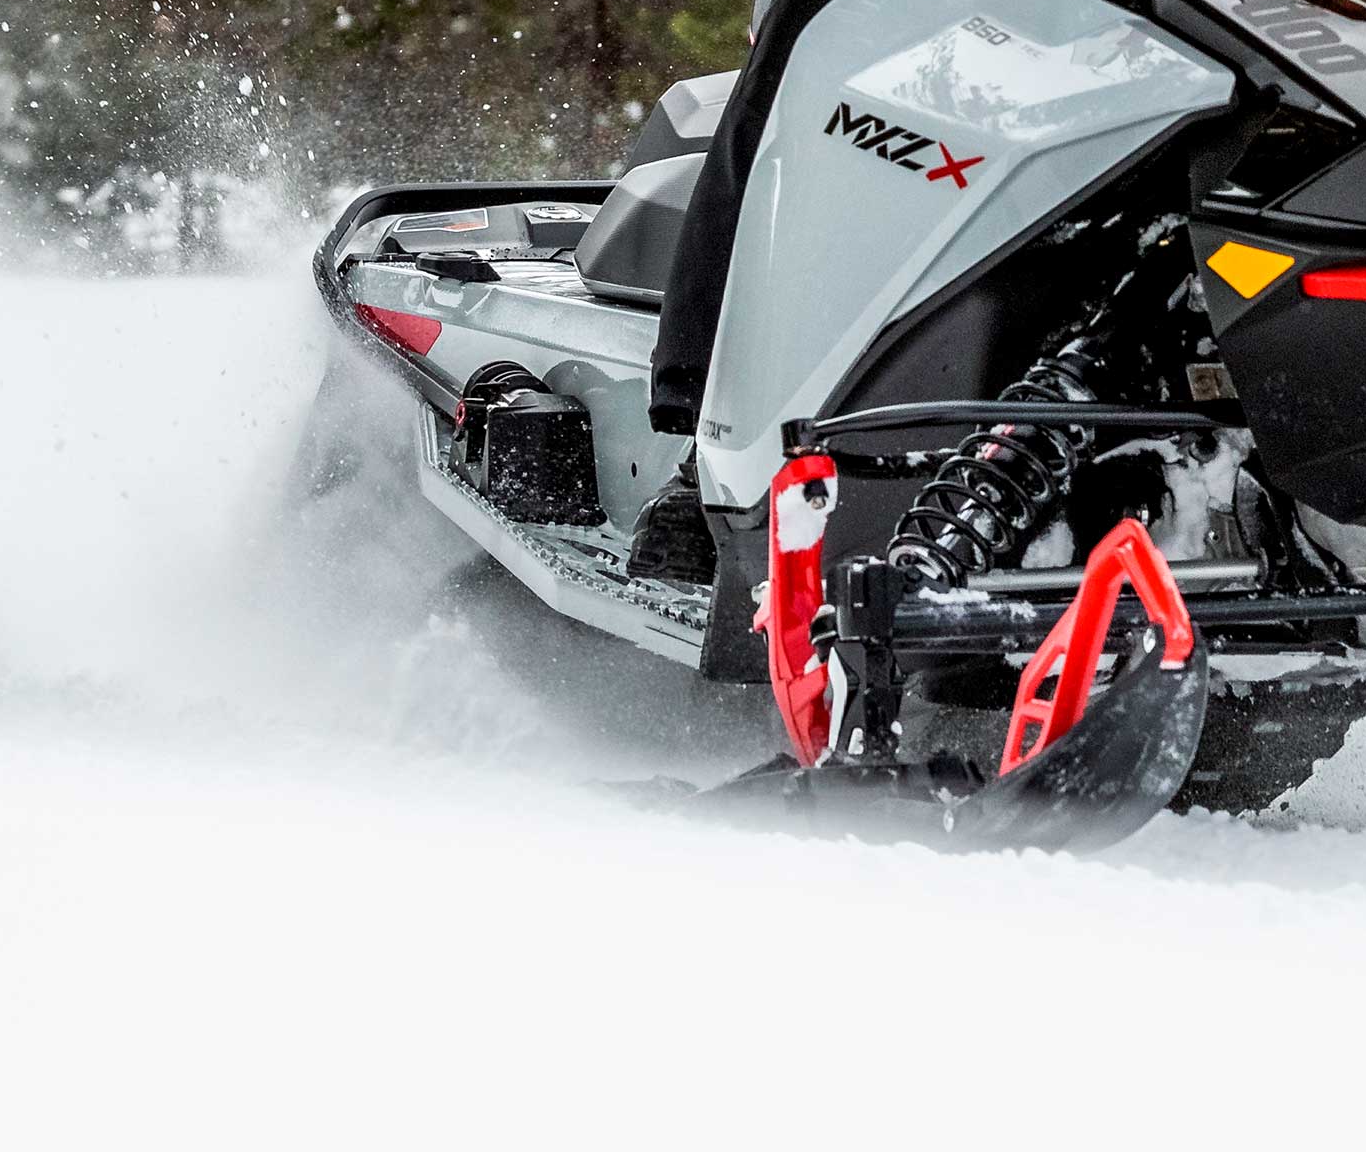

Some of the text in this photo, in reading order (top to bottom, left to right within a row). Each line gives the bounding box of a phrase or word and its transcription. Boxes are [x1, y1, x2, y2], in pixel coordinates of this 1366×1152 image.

[961, 16, 1011, 46] 850
[823, 101, 986, 190] MXZ X
